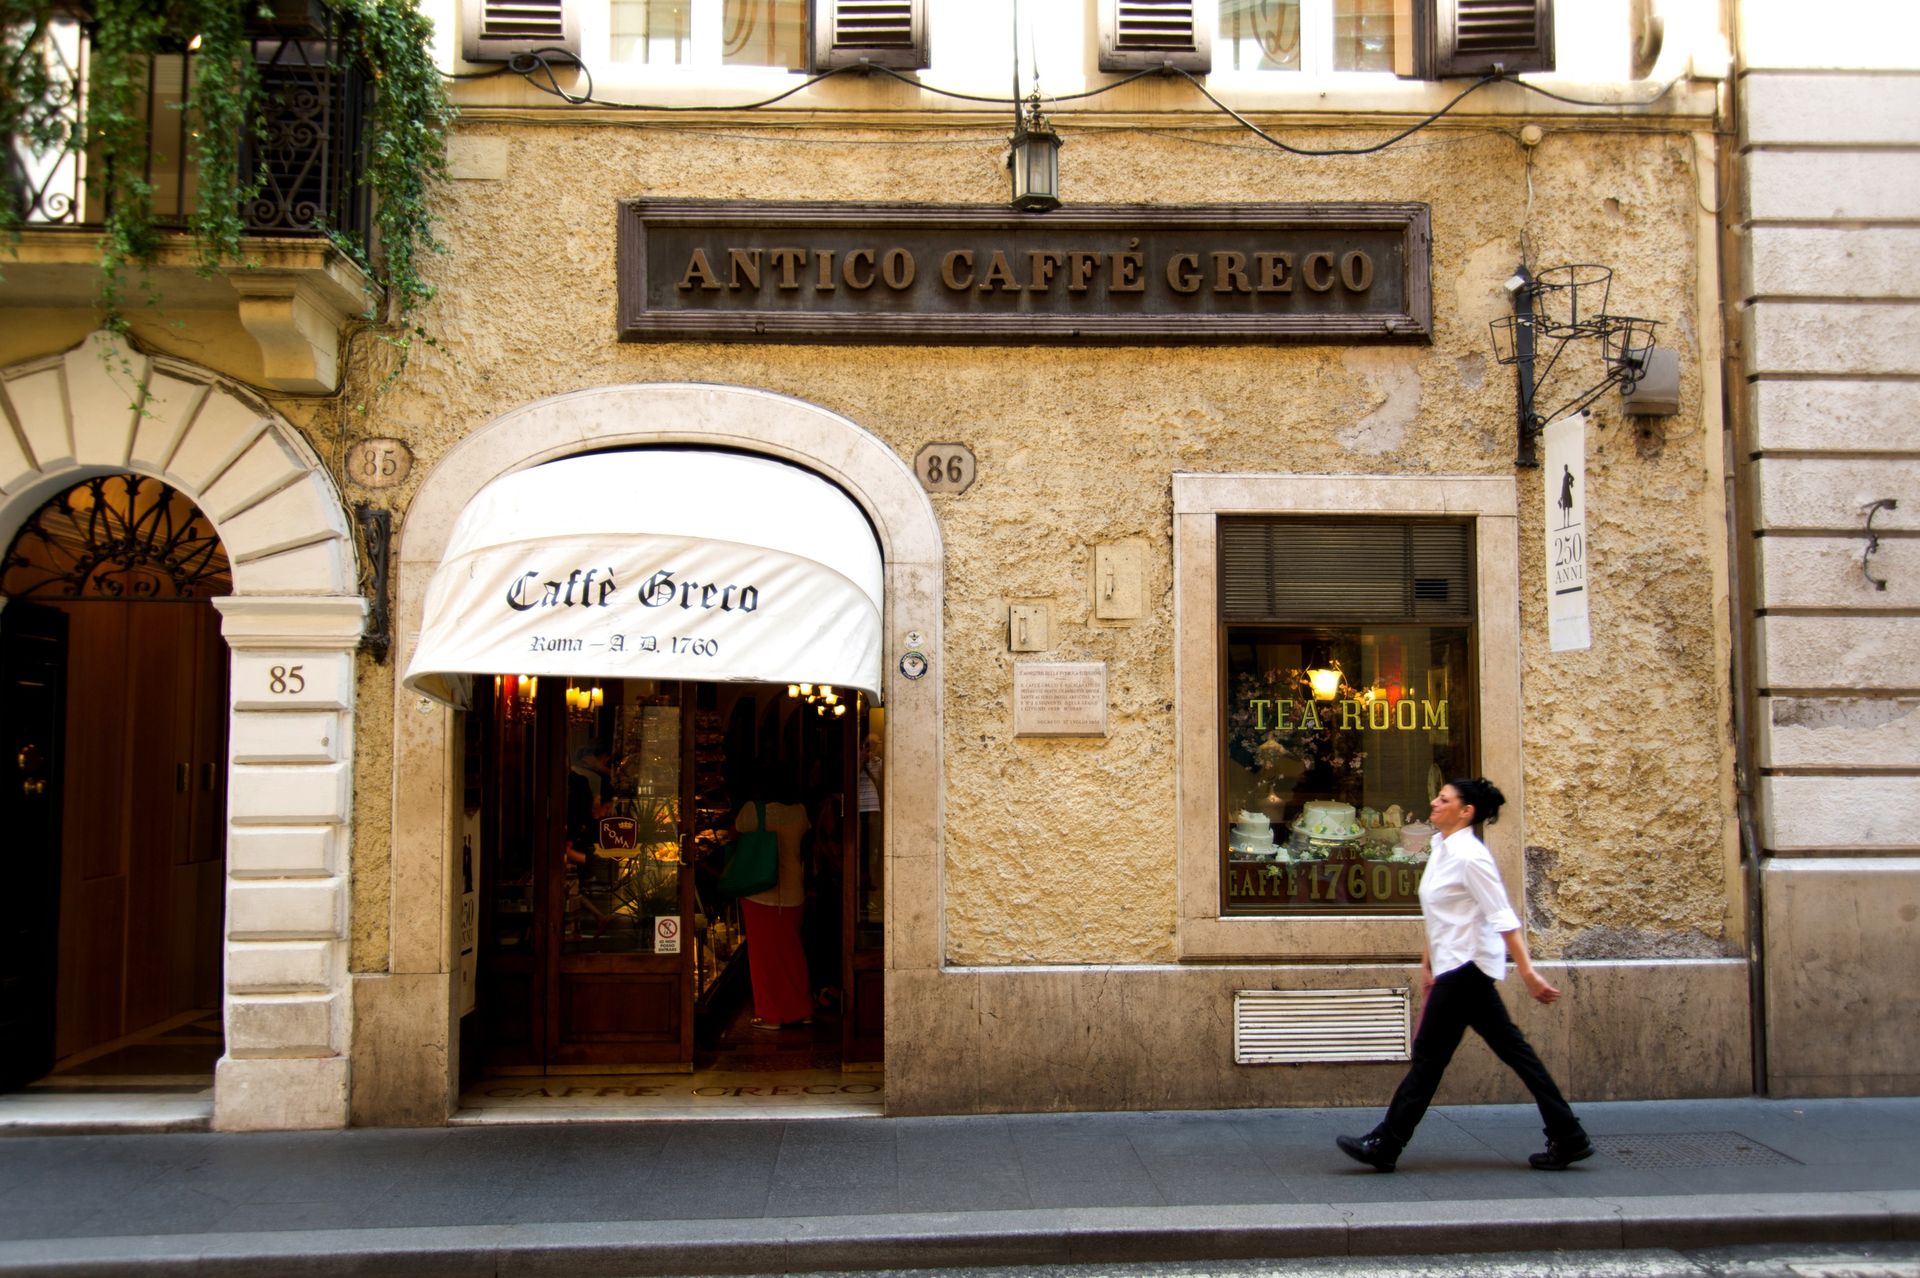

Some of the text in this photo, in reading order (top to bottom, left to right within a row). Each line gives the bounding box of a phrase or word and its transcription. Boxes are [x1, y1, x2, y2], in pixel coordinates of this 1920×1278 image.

[678, 247, 917, 291] ANTICO
[1166, 250, 1375, 293] GRECO
[363, 449, 397, 476] 85
[927, 455, 963, 484] 86
[1554, 532, 1583, 567] 250
[1554, 564, 1583, 585] ANNI
[506, 567, 759, 613] Caffè Greco
[530, 636, 583, 652] Roma
[671, 636, 719, 657] 1760
[269, 665, 305, 694] 85
[1250, 699, 1449, 730] TEA ROOM
[603, 823, 629, 848] ROMA
[1308, 863, 1393, 901] 1760
